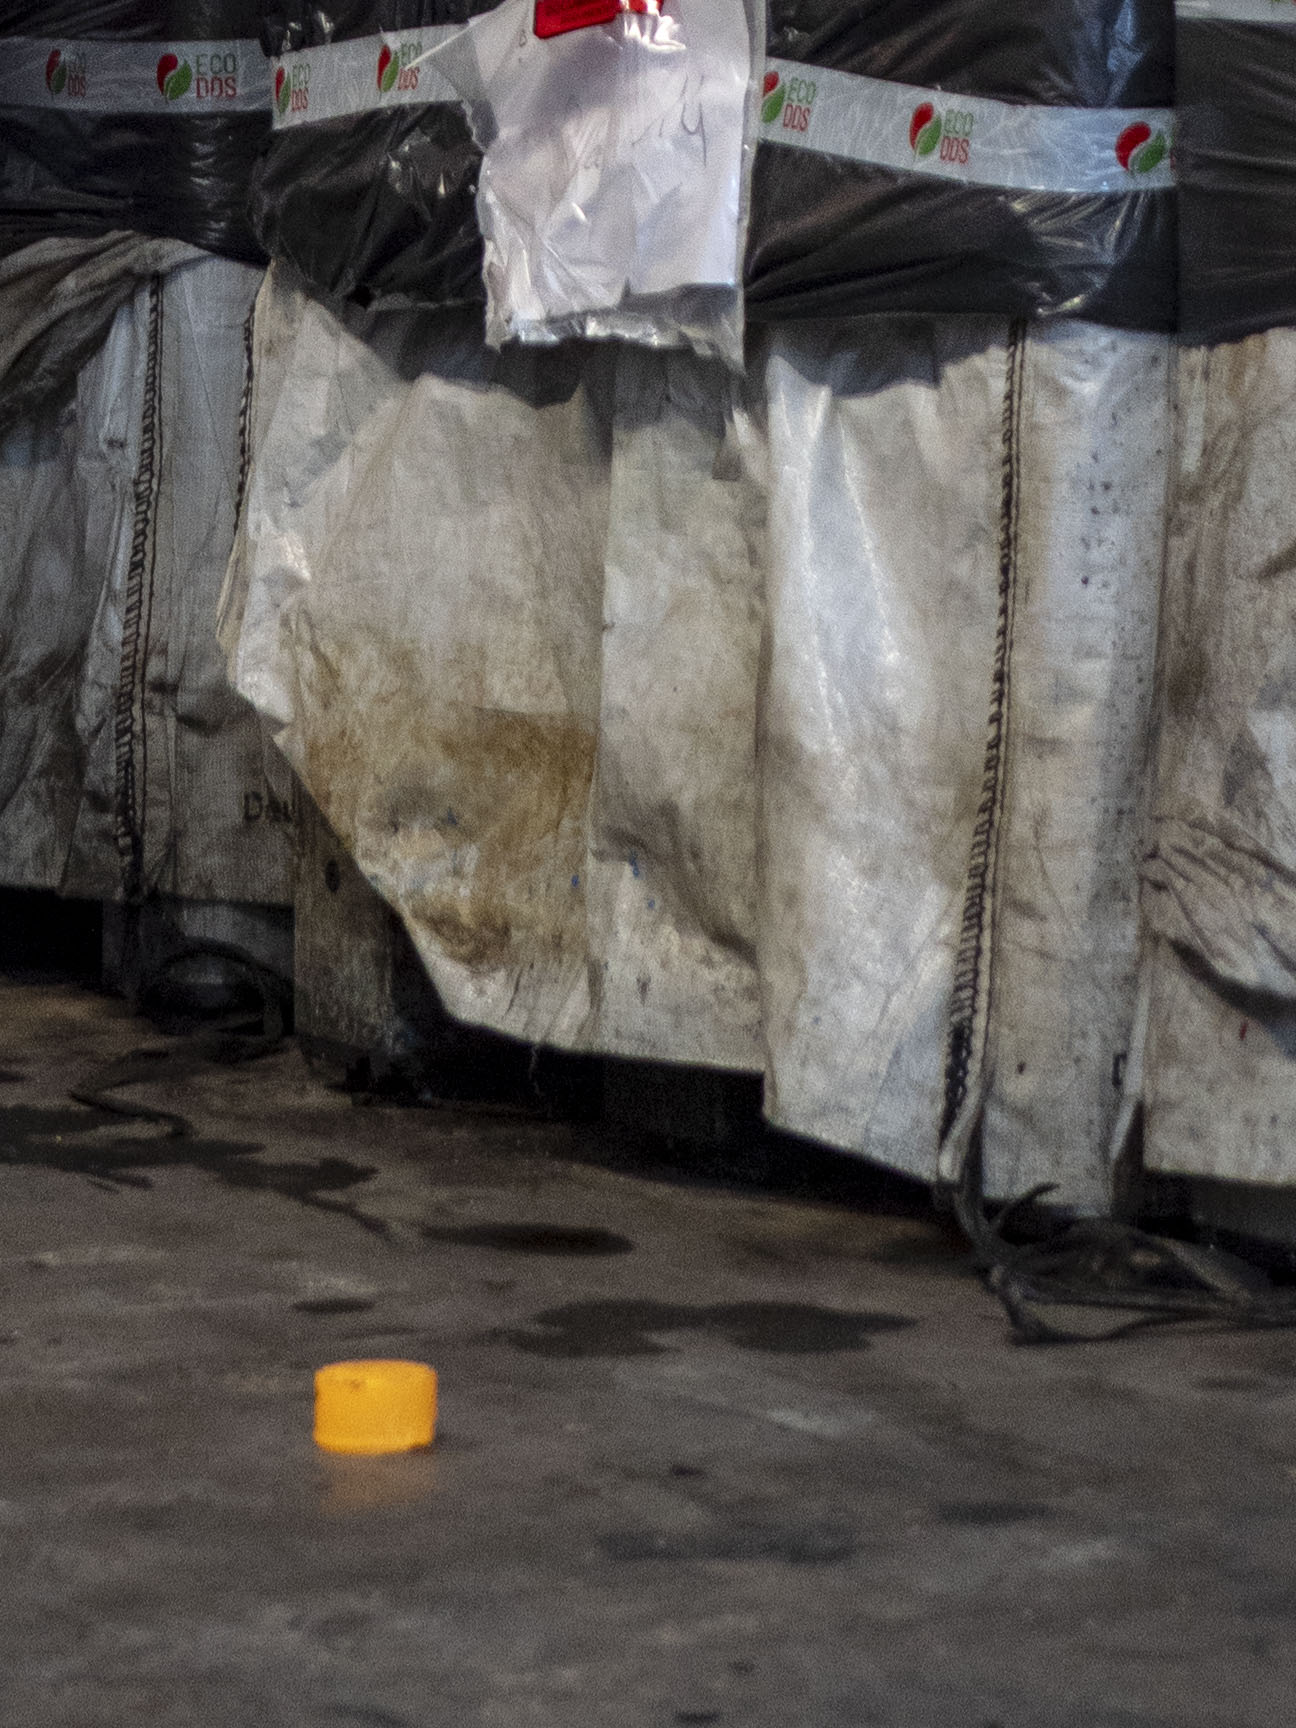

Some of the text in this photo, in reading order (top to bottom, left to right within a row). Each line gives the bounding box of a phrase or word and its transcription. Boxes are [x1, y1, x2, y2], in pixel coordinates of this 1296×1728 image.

[196, 52, 237, 74] ECO
[195, 76, 237, 99] DDS
[289, 88, 309, 112] DDS
[785, 76, 817, 104] ECO
[781, 101, 810, 131] DDS
[941, 109, 971, 137] ECO
[937, 135, 968, 164] DDS
